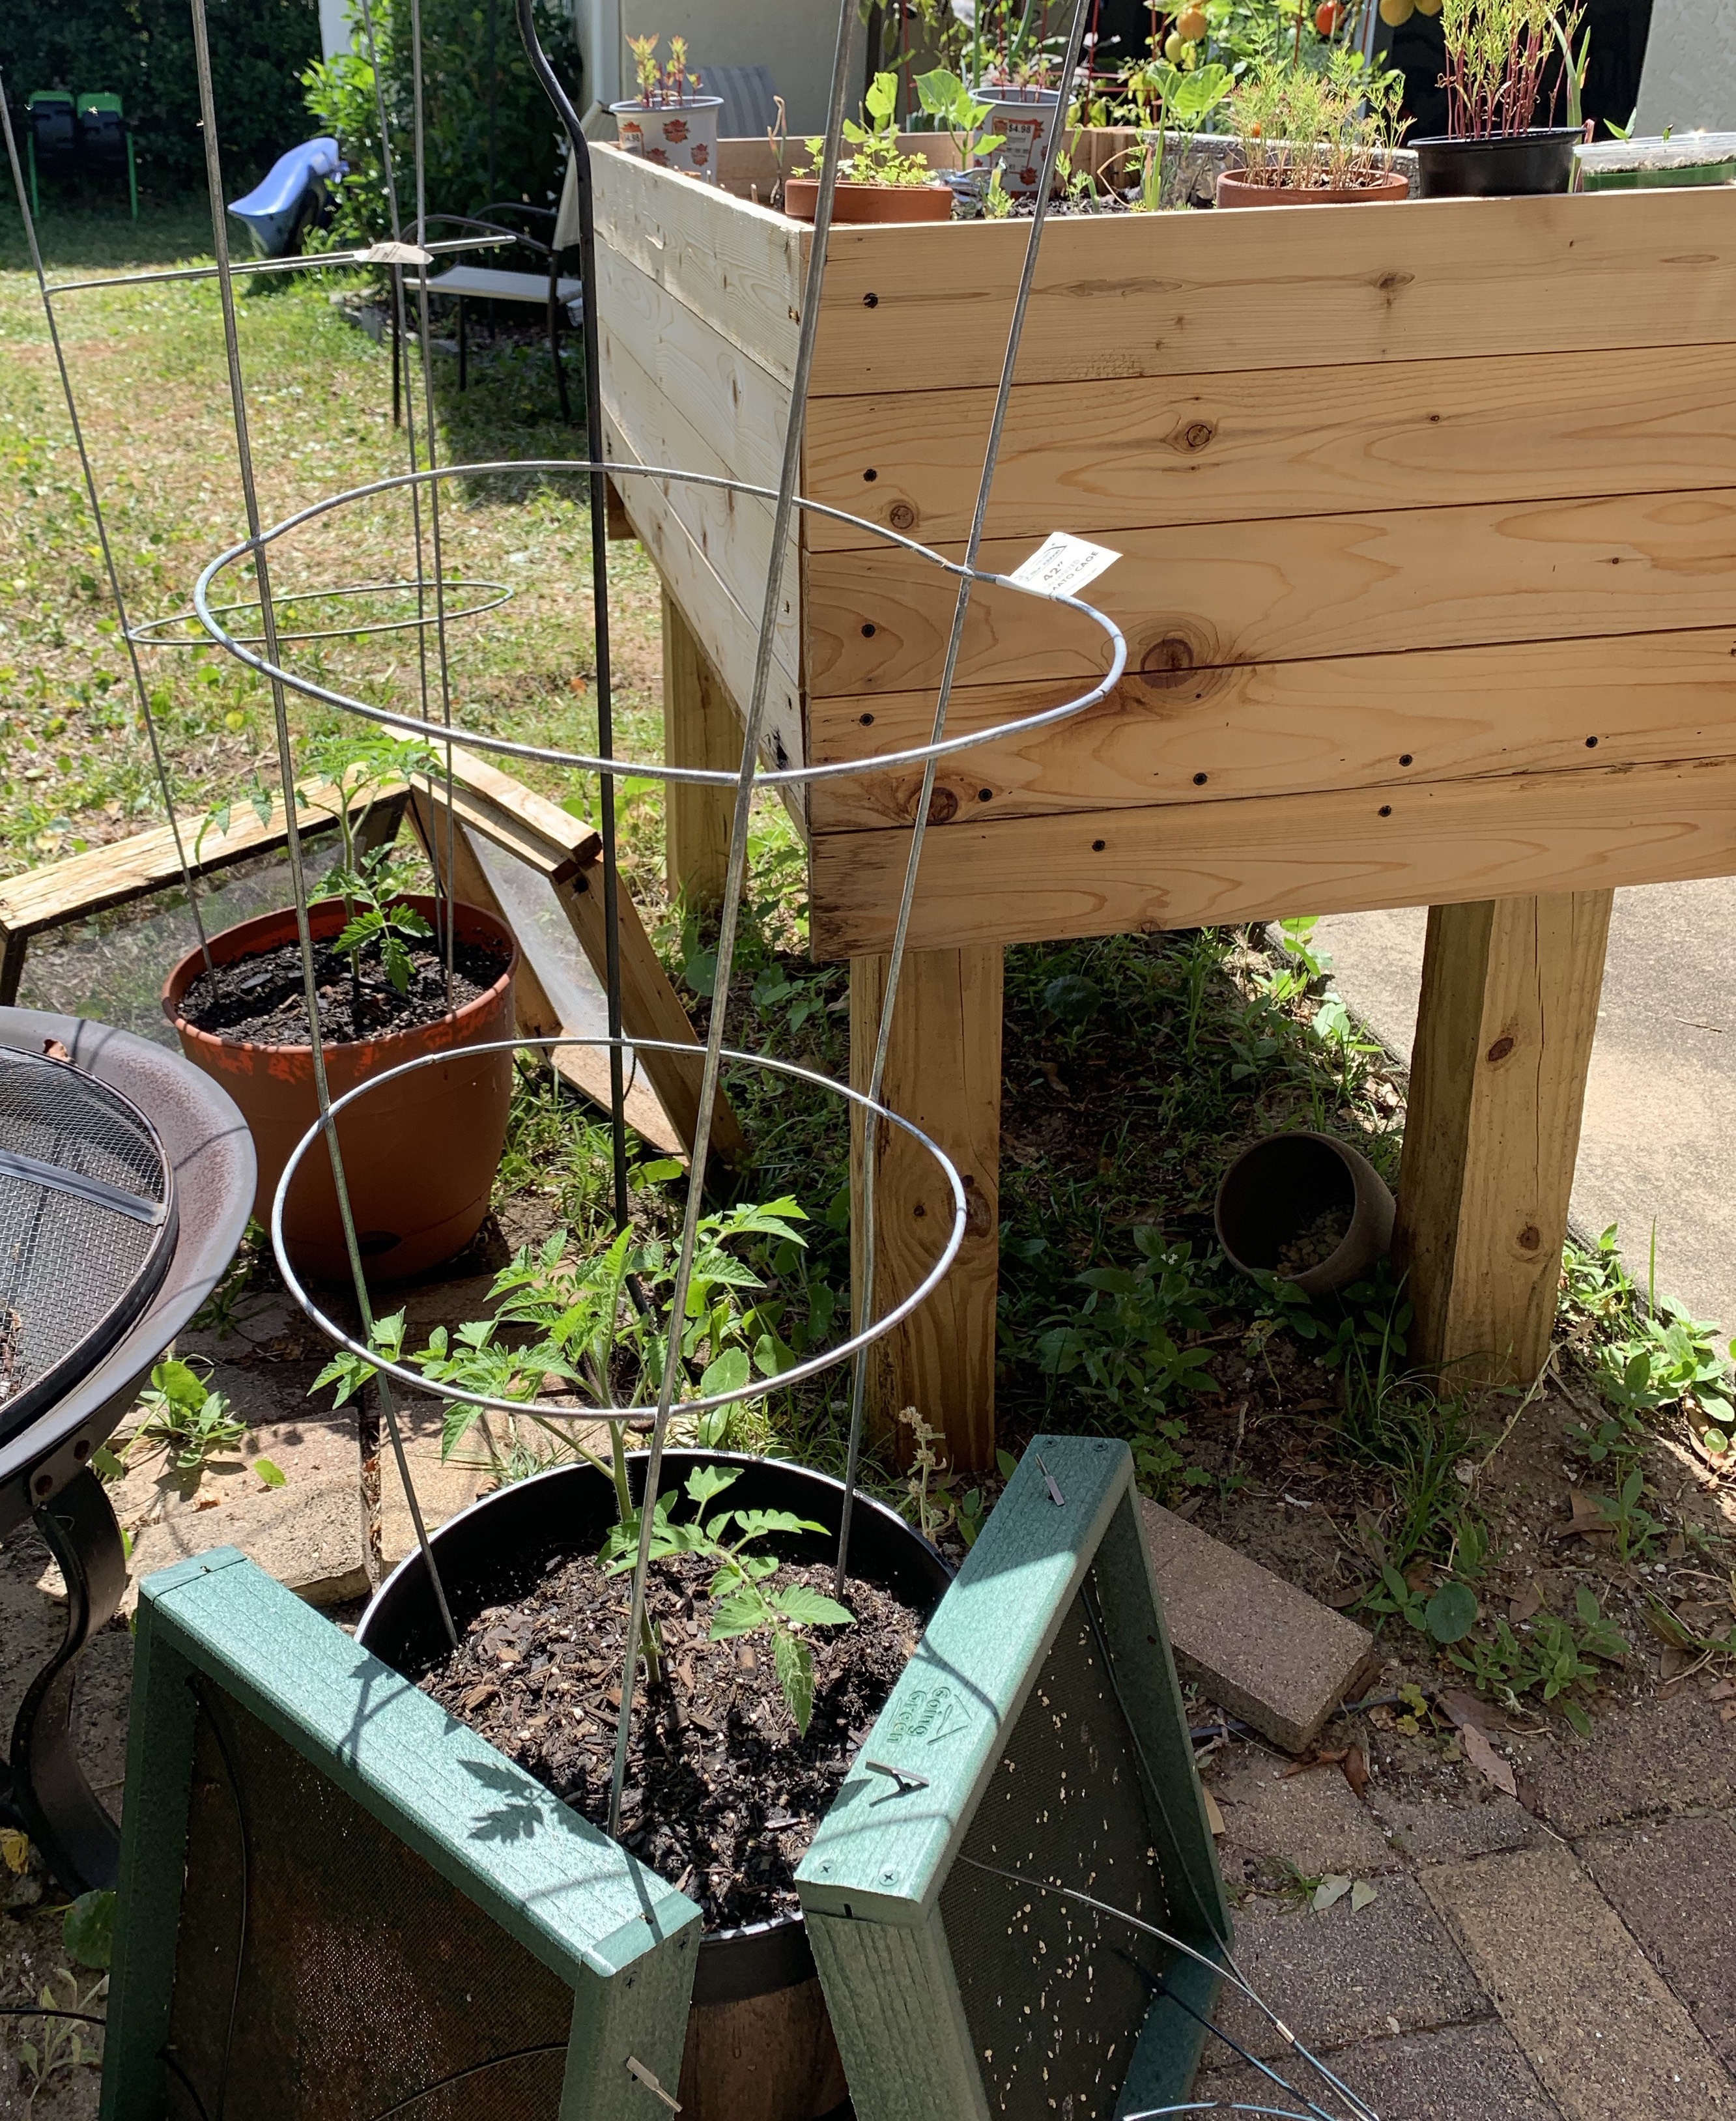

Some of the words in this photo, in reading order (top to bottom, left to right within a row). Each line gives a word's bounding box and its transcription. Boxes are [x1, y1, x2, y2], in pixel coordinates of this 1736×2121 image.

[1044, 561, 1063, 581] 42"
[1075, 551, 1098, 571] CAGE
[887, 1690, 926, 1743] Green
[907, 1687, 950, 1737] Going
